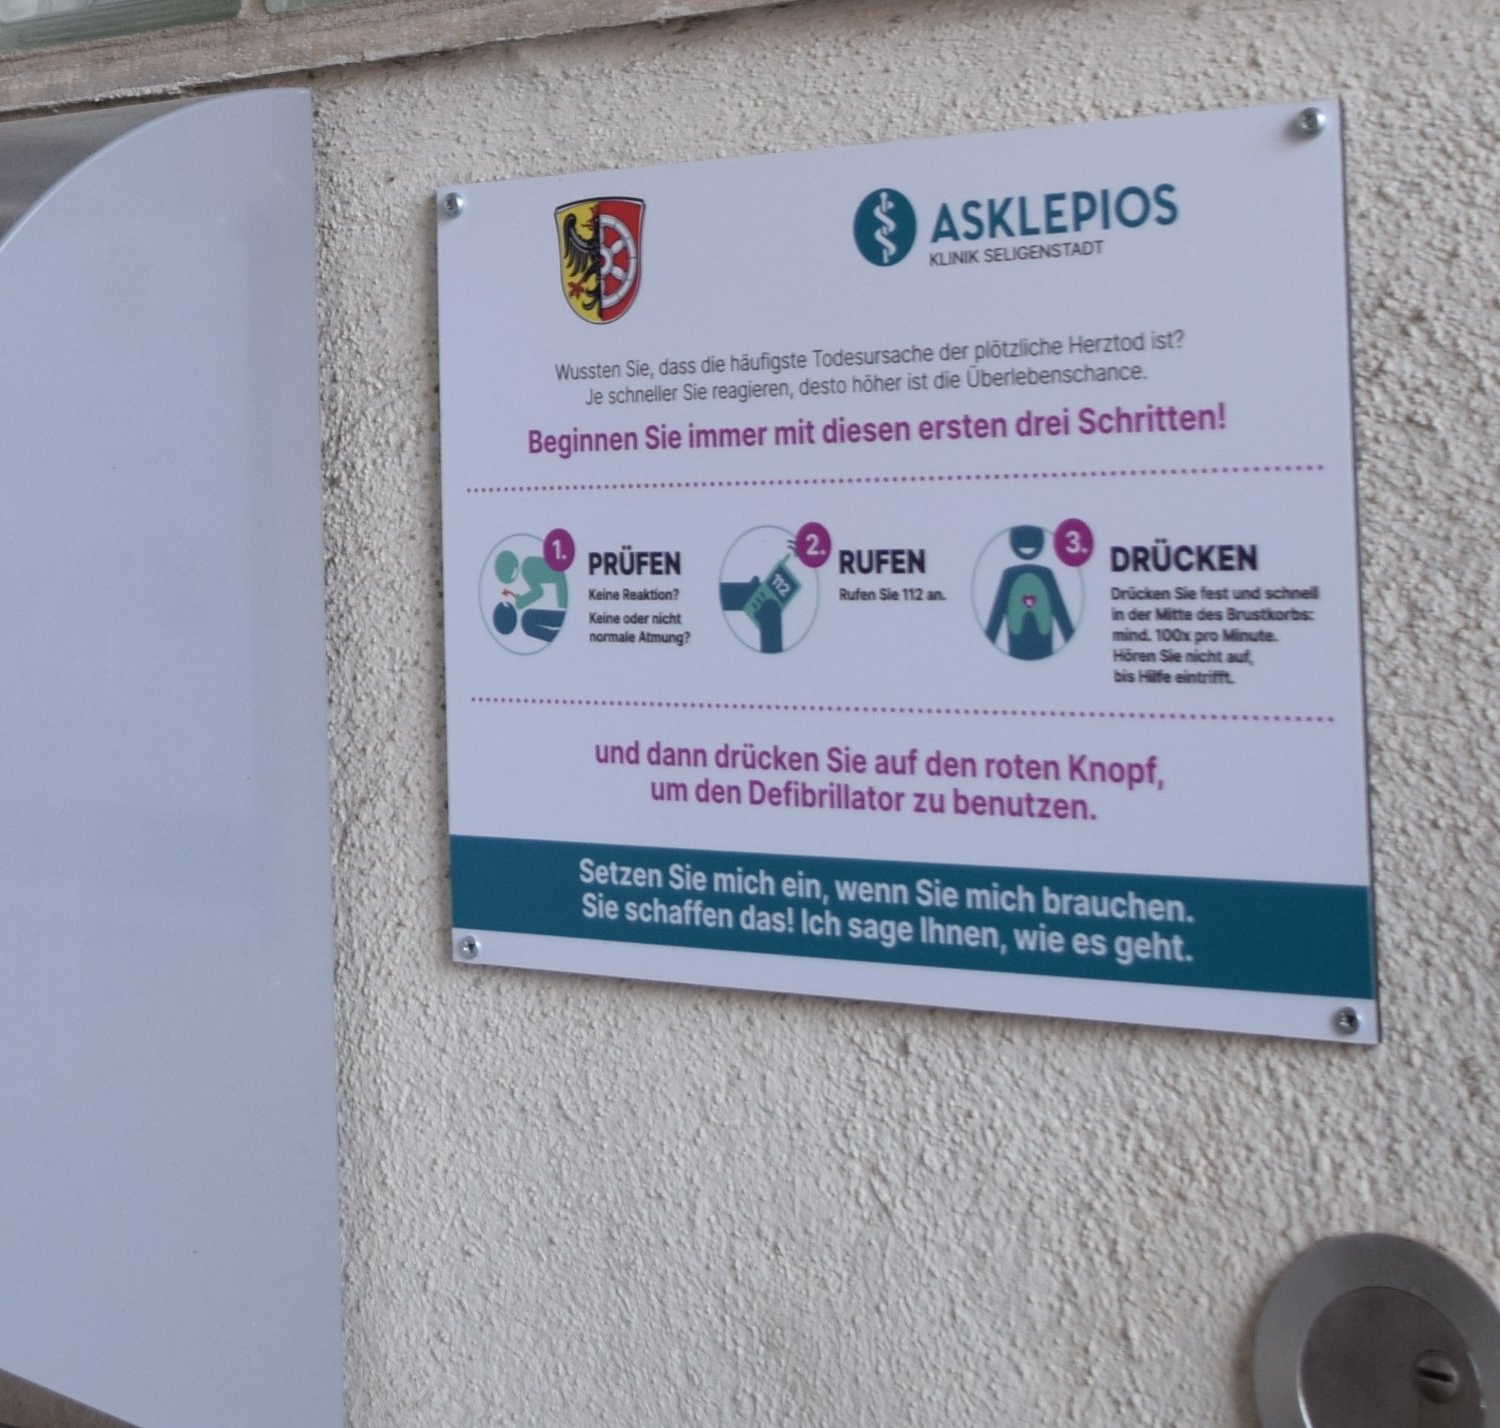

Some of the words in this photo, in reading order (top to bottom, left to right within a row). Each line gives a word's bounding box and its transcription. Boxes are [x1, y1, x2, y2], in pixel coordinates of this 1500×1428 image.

[930, 183, 1179, 242] ASKLEPIOS
[929, 249, 980, 266] KLINIK
[984, 239, 1104, 263] SELIGENSTADT
[554, 361, 621, 381] Wussten
[625, 359, 655, 381] Sie,
[658, 356, 696, 376] dass
[699, 355, 726, 374] die
[729, 350, 808, 377] häufigste
[811, 344, 934, 368] Todesursache
[938, 343, 969, 363] der
[974, 335, 1064, 363] plötzliche
[1067, 332, 1146, 354] Herztod
[1150, 329, 1184, 351] ist?
[584, 388, 604, 406] Je
[608, 385, 678, 404] schneller
[682, 383, 708, 401] Sie
[712, 379, 794, 404] reagieren,
[798, 376, 848, 397] desto
[852, 373, 902, 394] höher
[907, 371, 929, 391] ist
[932, 370, 961, 390] die
[966, 364, 1148, 389] Überlebenschance.
[528, 428, 638, 459] Beginnen
[644, 425, 682, 450] Sie
[688, 423, 768, 449] immer
[775, 420, 814, 445] mit
[822, 415, 910, 444] diesen
[918, 411, 1007, 440] ersten
[1015, 408, 1070, 437] drei
[1078, 402, 1226, 435] Schritten!
[552, 540, 567, 560] 1.
[806, 534, 826, 555] 2.
[1065, 531, 1088, 554] 3.
[588, 545, 681, 576] PRÜFEN
[839, 549, 926, 574] RUFEN
[1110, 538, 1258, 572] DRÜCKEN
[588, 588, 619, 601] Keine
[622, 587, 679, 601] Reaktion?
[770, 573, 791, 597] 112
[839, 588, 876, 601] Rufen
[878, 588, 900, 601] Sie
[903, 588, 923, 601] 112
[927, 590, 946, 601] an.
[1111, 586, 1172, 600] Drücken
[1175, 586, 1197, 600] Sie
[1200, 586, 1230, 600] fest
[1232, 586, 1261, 600] und
[1264, 586, 1319, 600] schnell
[589, 612, 620, 625] Keine
[623, 612, 649, 625] oder
[652, 611, 682, 626] nicht
[1112, 608, 1125, 621] in
[1128, 607, 1152, 621] der
[1154, 607, 1193, 622] Mitte
[1196, 607, 1223, 622] des
[1226, 607, 1315, 622] Brustkorbs:
[589, 631, 636, 644] normale
[639, 631, 690, 647] Atmung?
[1112, 629, 1151, 642] mind.
[1156, 629, 1190, 642] 100x
[1195, 631, 1219, 645] pro
[1222, 629, 1278, 642] Minute.
[1113, 649, 1157, 662] Hören
[1160, 649, 1182, 662] Sie
[1185, 649, 1222, 663] nicht
[1226, 649, 1254, 665] auf,
[1114, 669, 1135, 683] bis
[1139, 669, 1172, 683] Hilfe
[1175, 669, 1236, 684] eintrifft.
[594, 741, 640, 766] und
[646, 742, 708, 769] dann
[714, 743, 819, 773] drücken
[826, 747, 867, 774] Sie
[874, 749, 918, 777] auf
[925, 751, 977, 778] den
[985, 755, 1060, 781] roten
[1068, 755, 1165, 791] Knopf,
[651, 782, 688, 803] um
[694, 778, 742, 805] den
[749, 780, 905, 813] Defibrillator
[913, 791, 946, 814] zu
[953, 788, 1097, 821] benutzen.
[579, 859, 662, 889] Setzen
[668, 863, 707, 891] Sie
[713, 866, 774, 896] mich
[781, 871, 828, 905] ein,
[834, 878, 909, 906] wenn
[915, 877, 958, 908] Sie
[966, 880, 1034, 914] mich
[1042, 887, 1194, 924] brauchen.
[582, 894, 620, 921] Sie
[624, 897, 734, 930] schaffen
[739, 905, 795, 935] das!
[801, 907, 841, 937] Ich
[848, 917, 914, 947] sage
[920, 915, 1007, 954] Ihnen,
[1014, 922, 1064, 953] wie
[1072, 930, 1107, 957] es
[1114, 932, 1193, 965] geht.
